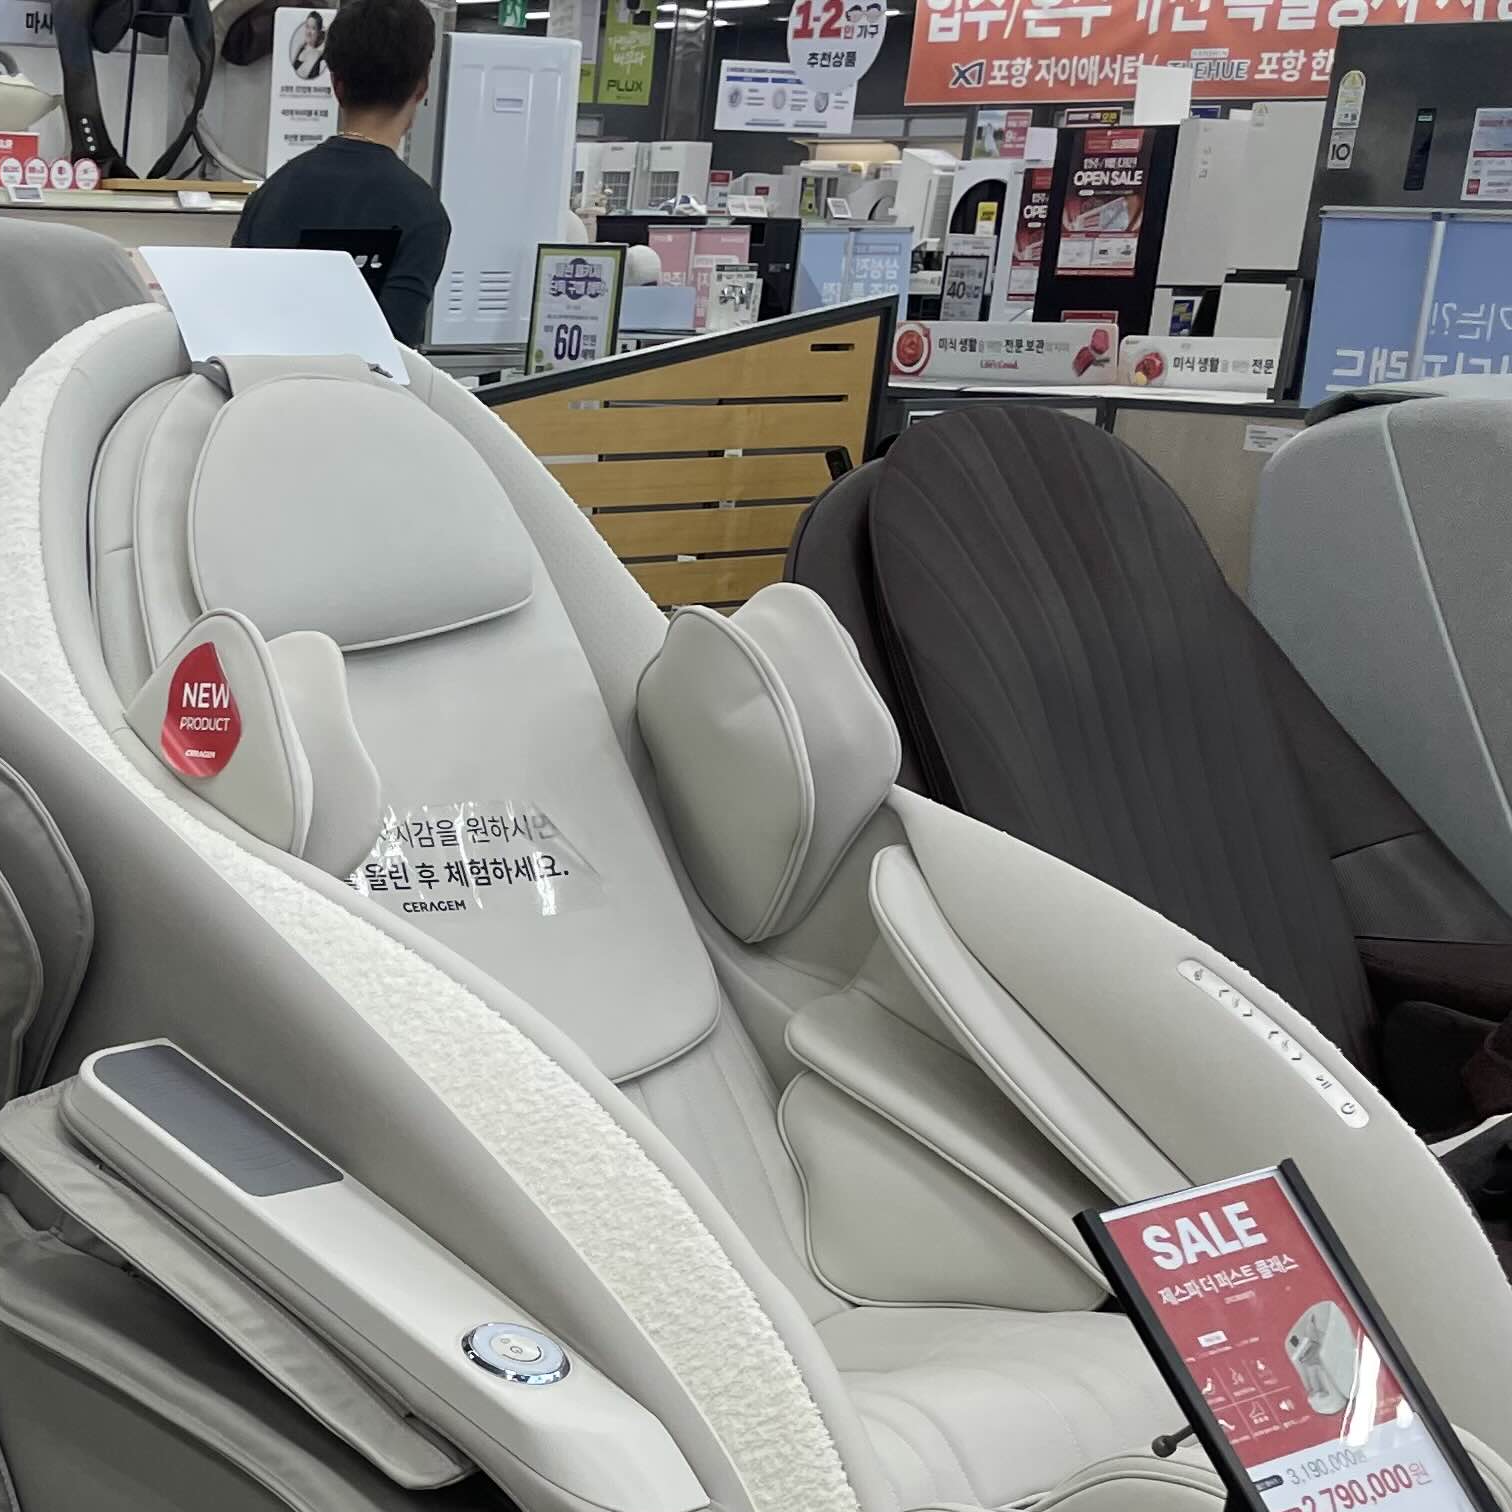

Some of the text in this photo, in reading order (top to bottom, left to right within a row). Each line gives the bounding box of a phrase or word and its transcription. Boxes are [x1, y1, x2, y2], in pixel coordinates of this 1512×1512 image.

[856, 24, 879, 39] 가구
[807, 51, 857, 68] 추천상품
[988, 58, 1032, 87] 포항
[1254, 51, 1306, 82] 포항
[607, 79, 643, 92] PLUX
[1073, 170, 1144, 186] OPEN SALE
[554, 323, 582, 361] 60
[938, 337, 957, 352] 미식
[1173, 356, 1196, 372] 미식
[1251, 358, 1274, 375] 전문
[182, 682, 230, 709] NEW
[179, 716, 231, 731] PRODUCT
[364, 862, 412, 891] 올린
[414, 862, 440, 890] 후
[444, 854, 569, 889] 체험하세요.
[402, 899, 467, 913] CERAGEM
[1142, 1201, 1268, 1270] SALE
[1199, 1273, 1220, 1293] 더
[1214, 1264, 1259, 1289] 퍼스트
